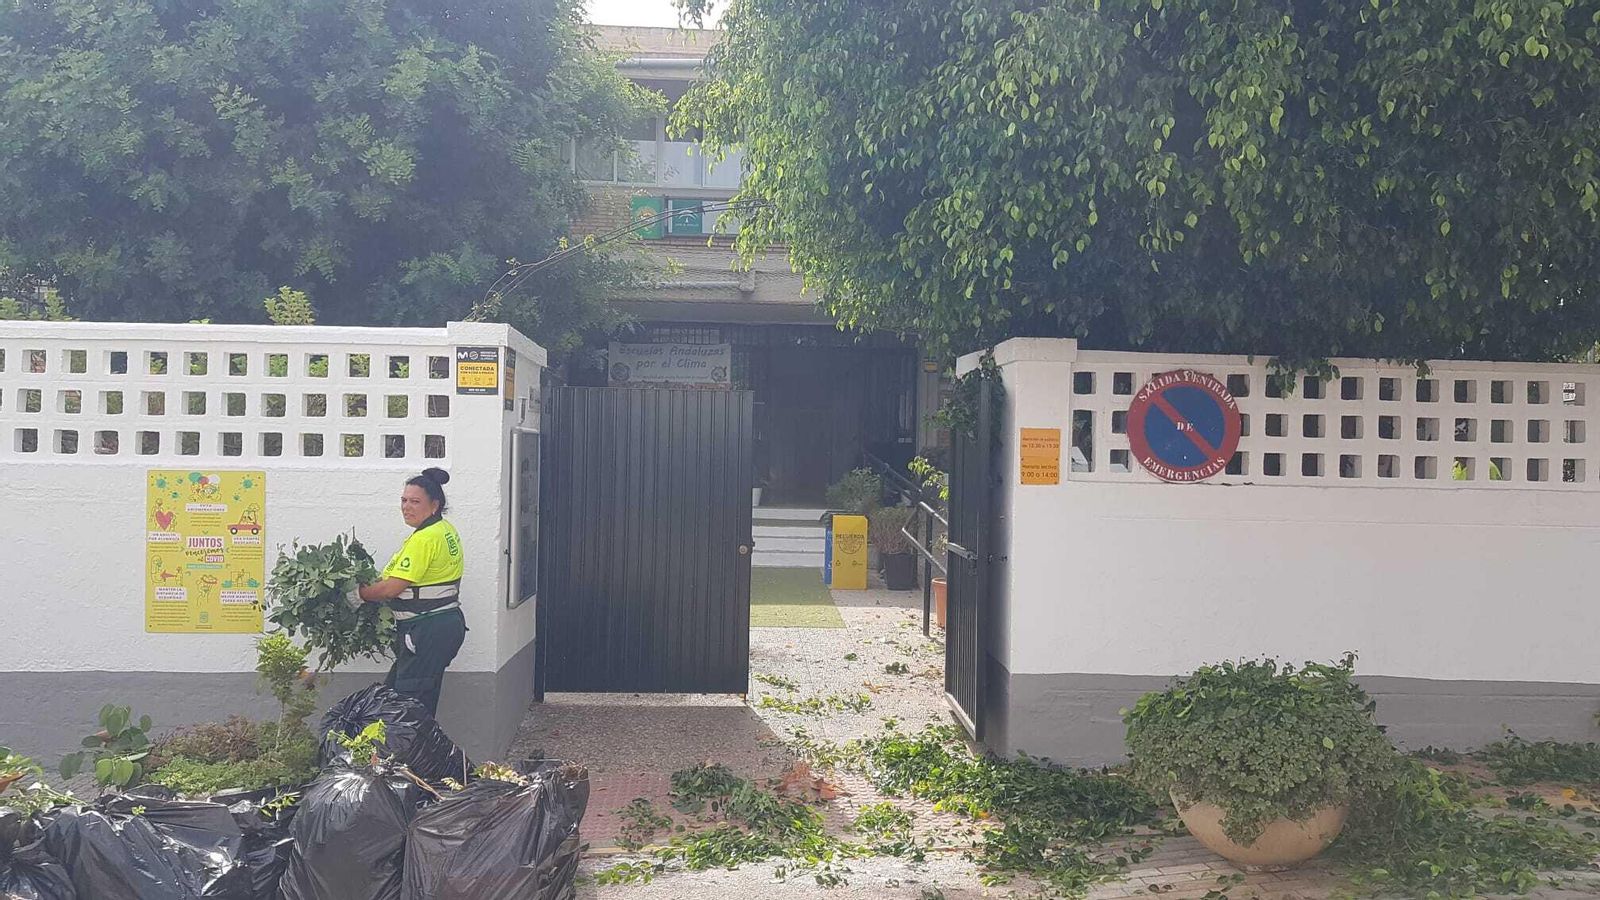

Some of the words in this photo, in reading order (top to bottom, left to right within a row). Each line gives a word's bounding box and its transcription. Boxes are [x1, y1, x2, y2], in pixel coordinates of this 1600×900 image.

[620, 346, 664, 355] Escuelas
[670, 346, 724, 356] Andaluzas
[636, 360, 656, 370] por
[662, 358, 672, 368] el
[676, 358, 707, 368] Clima
[1138, 374, 1180, 402] SALIDA
[1193, 372, 1236, 410] ENTRADA
[1176, 422, 1194, 432] DE
[1143, 456, 1225, 480] EMERGENCIAS
[188, 538, 222, 547] JUNTOS
